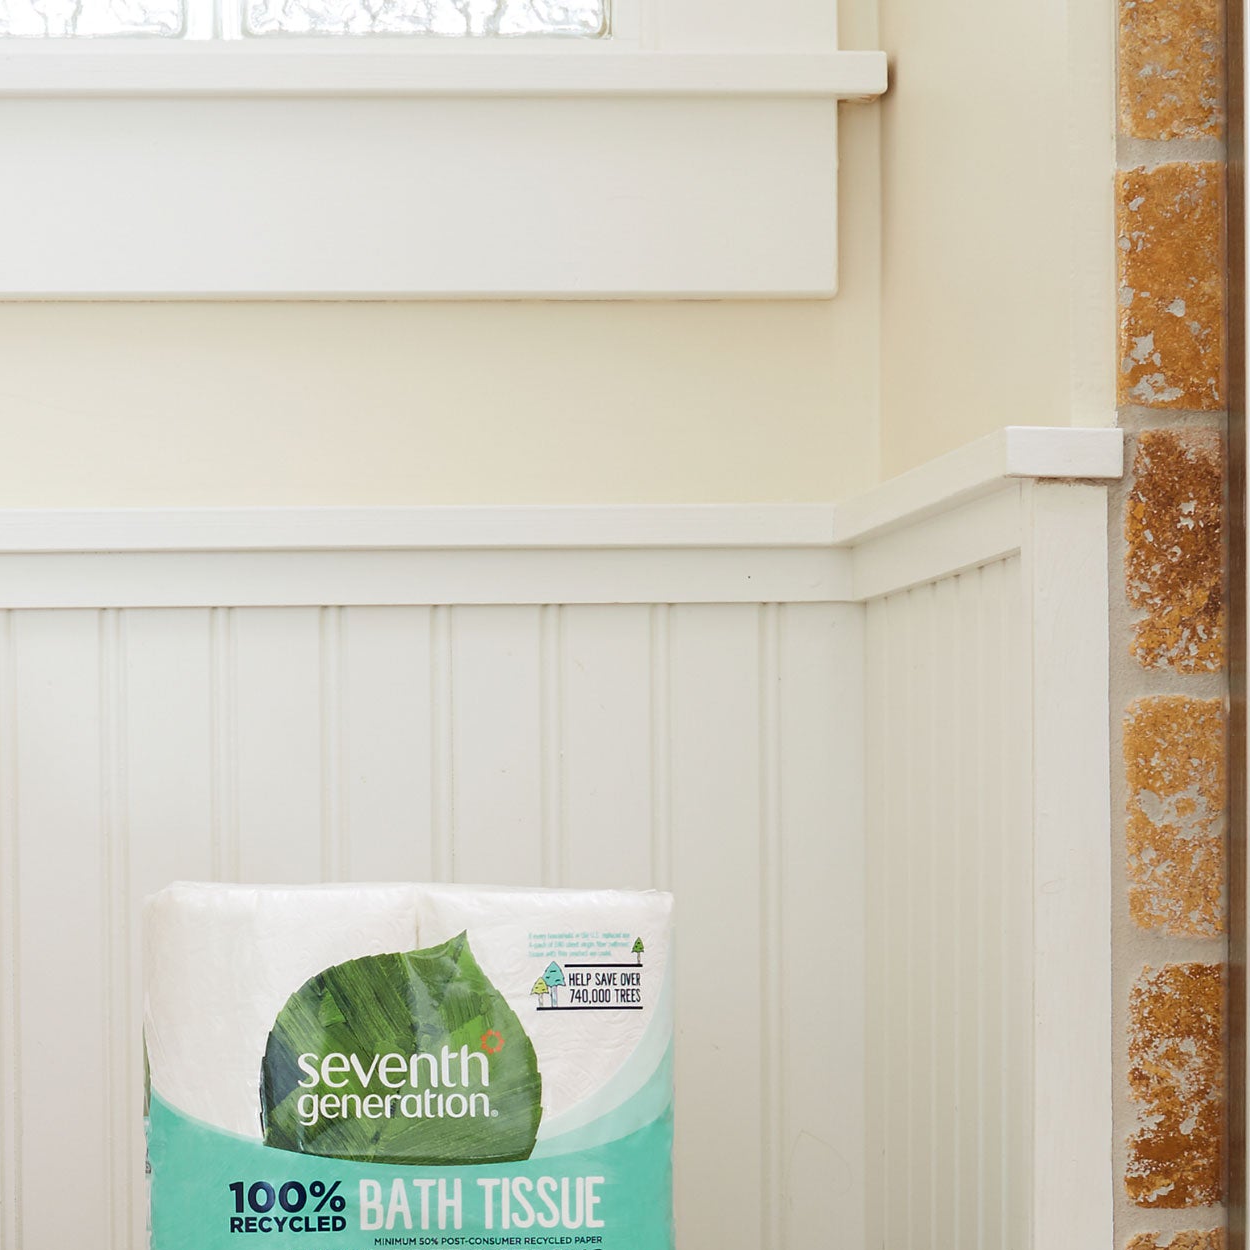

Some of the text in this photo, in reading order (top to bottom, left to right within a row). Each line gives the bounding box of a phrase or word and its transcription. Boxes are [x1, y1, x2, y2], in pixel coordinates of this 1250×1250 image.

[568, 972, 641, 986] HELP SAVE OVER
[570, 988, 641, 1004] 740,000 TREES
[297, 1044, 489, 1088] seventh
[229, 1180, 346, 1214] 100%
[359, 1176, 605, 1231] BATH TISSUE
[230, 1216, 346, 1233] RECYCLED
[374, 1236, 602, 1246] MINIMUM 50% POST-CONSUMER RECYCLED PAPER
